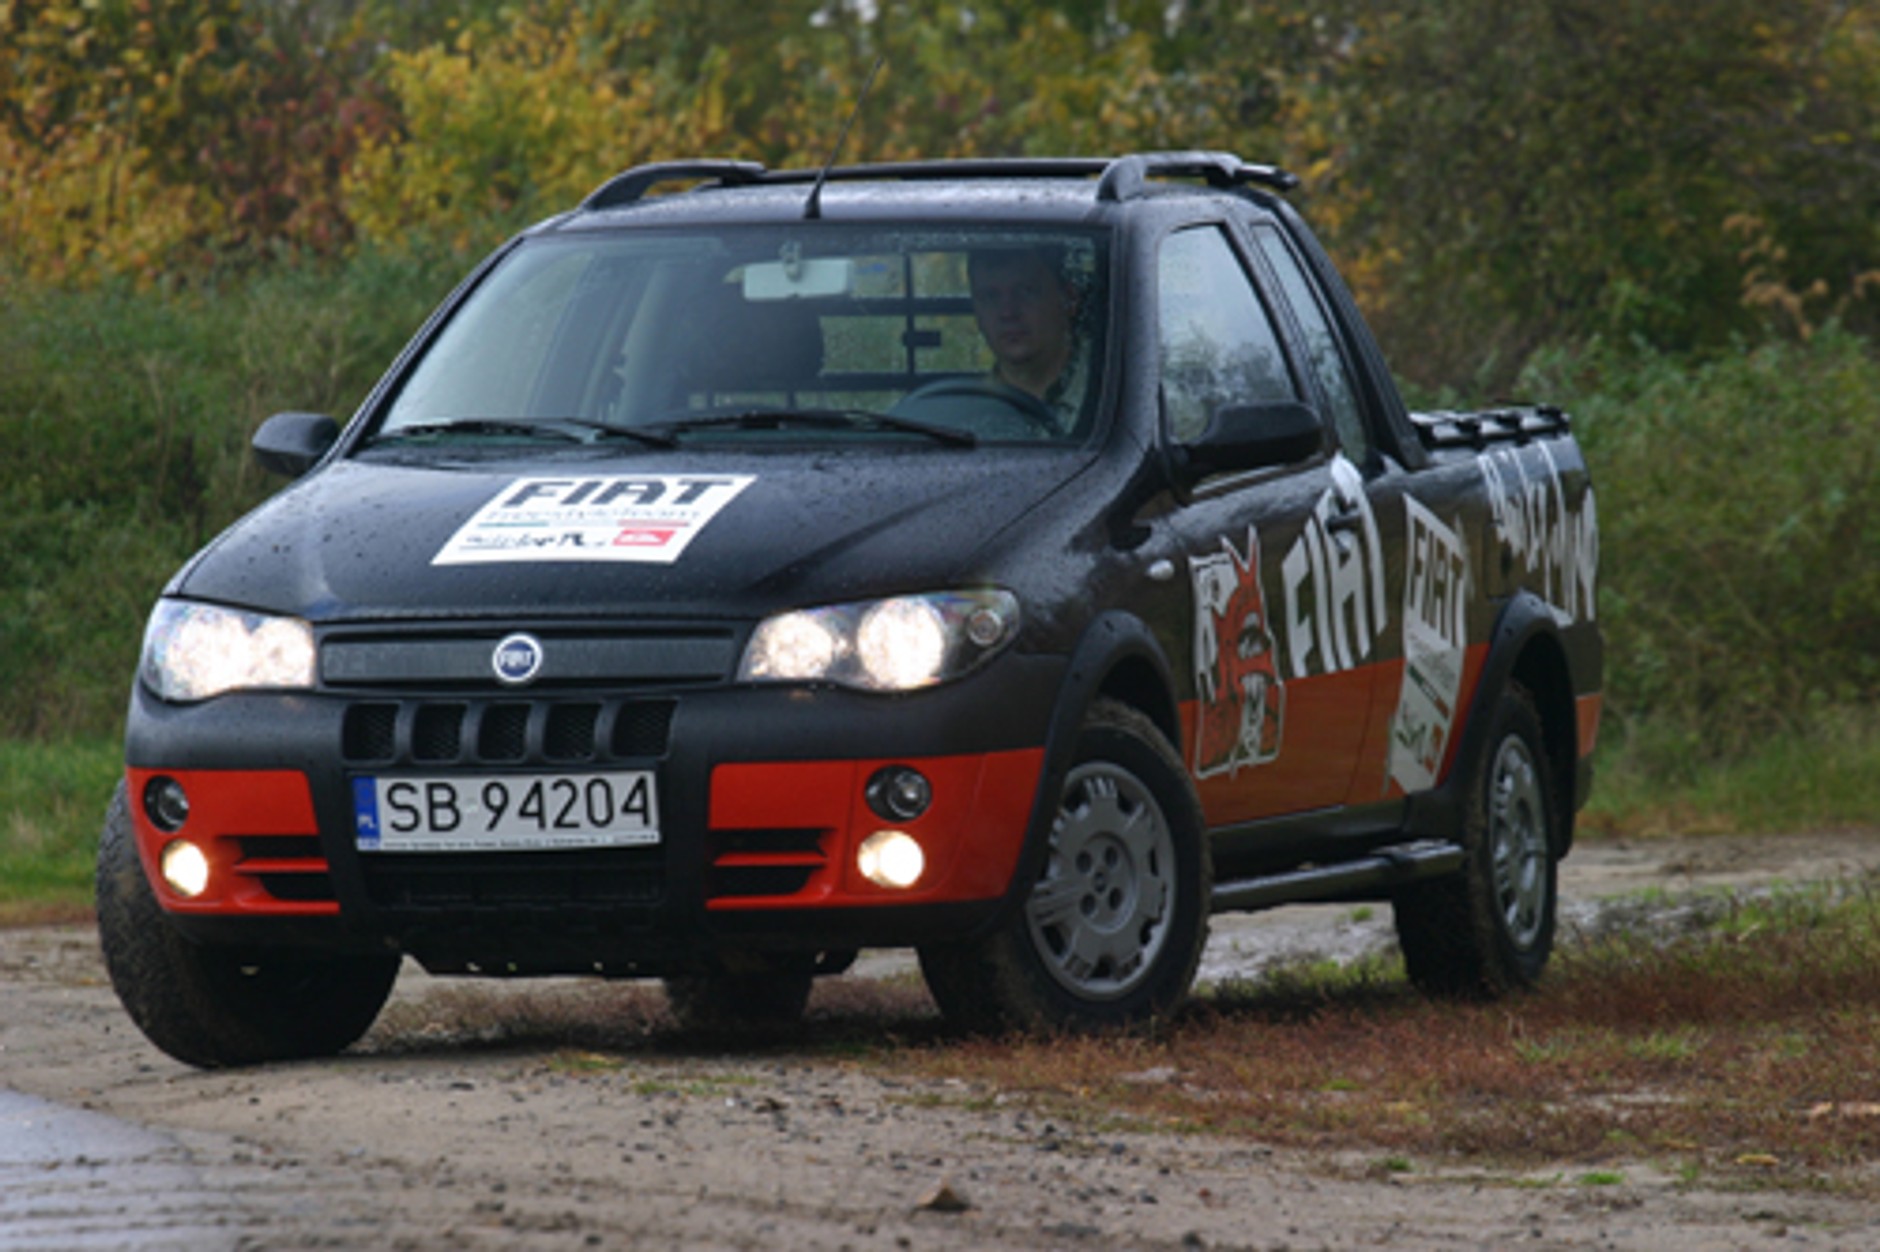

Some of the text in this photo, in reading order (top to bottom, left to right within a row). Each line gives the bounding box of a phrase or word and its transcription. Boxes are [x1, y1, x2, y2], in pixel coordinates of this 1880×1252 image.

[501, 478, 734, 508] FIAT
[386, 775, 651, 833] SB 94204
